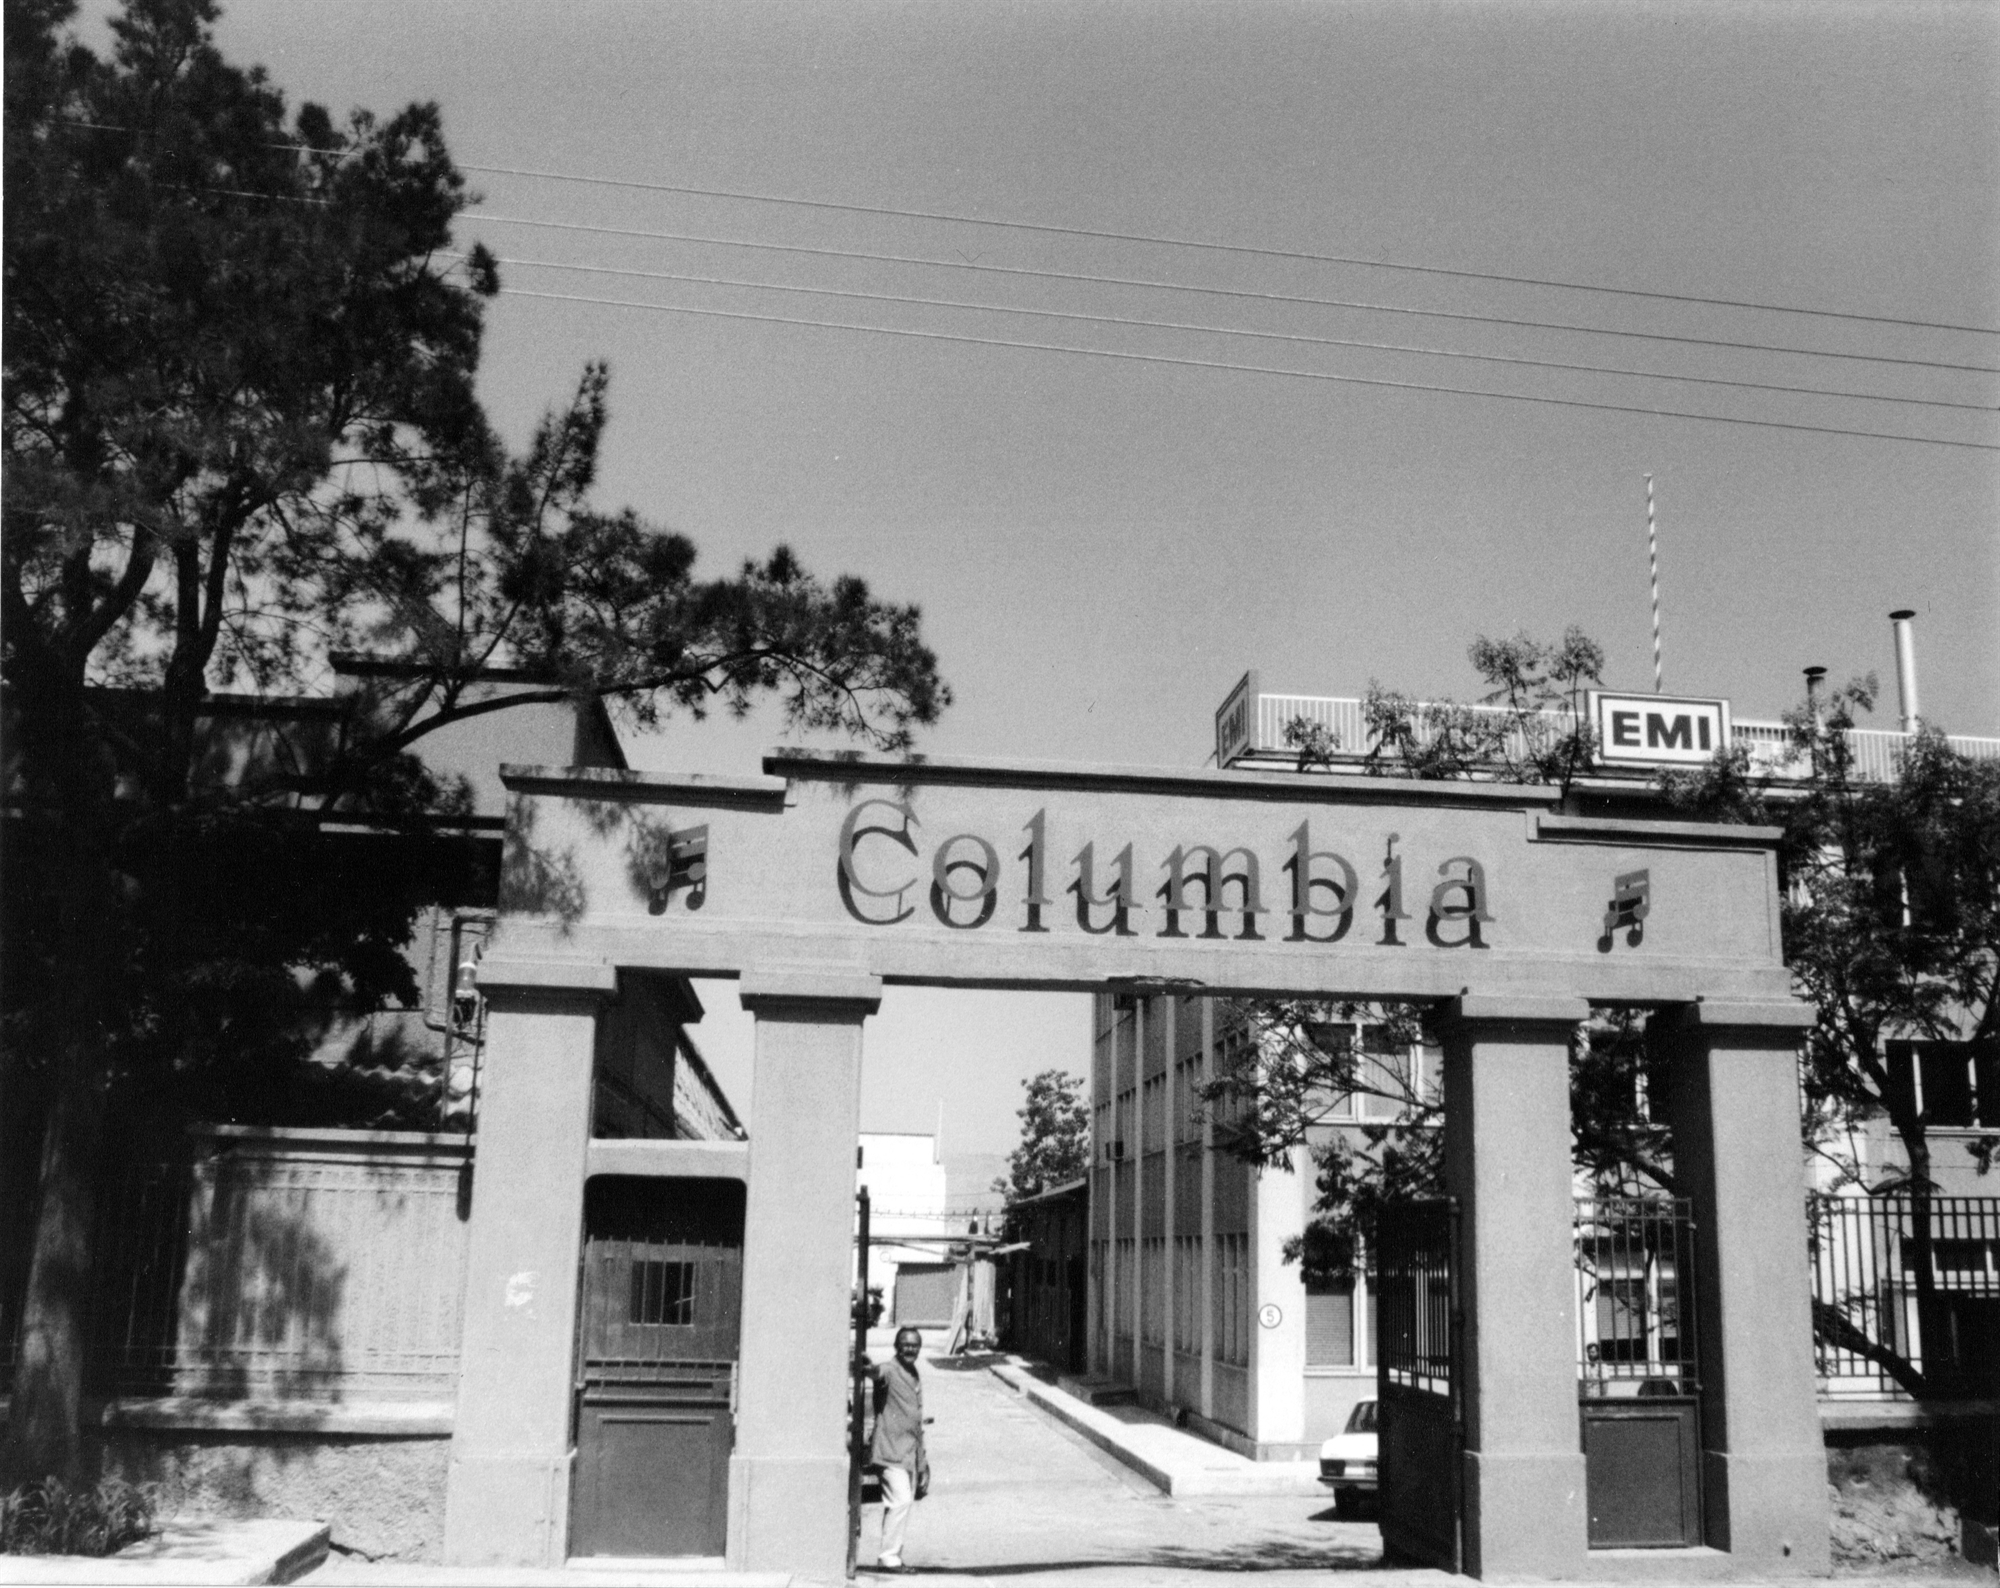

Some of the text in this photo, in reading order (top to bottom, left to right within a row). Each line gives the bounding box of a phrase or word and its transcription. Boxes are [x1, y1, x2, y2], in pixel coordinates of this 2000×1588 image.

[1221, 698, 1246, 760] EMI
[1612, 710, 1711, 751] EMI
[837, 799, 1497, 924] Columbia
[1266, 1309, 1275, 1323] 5
